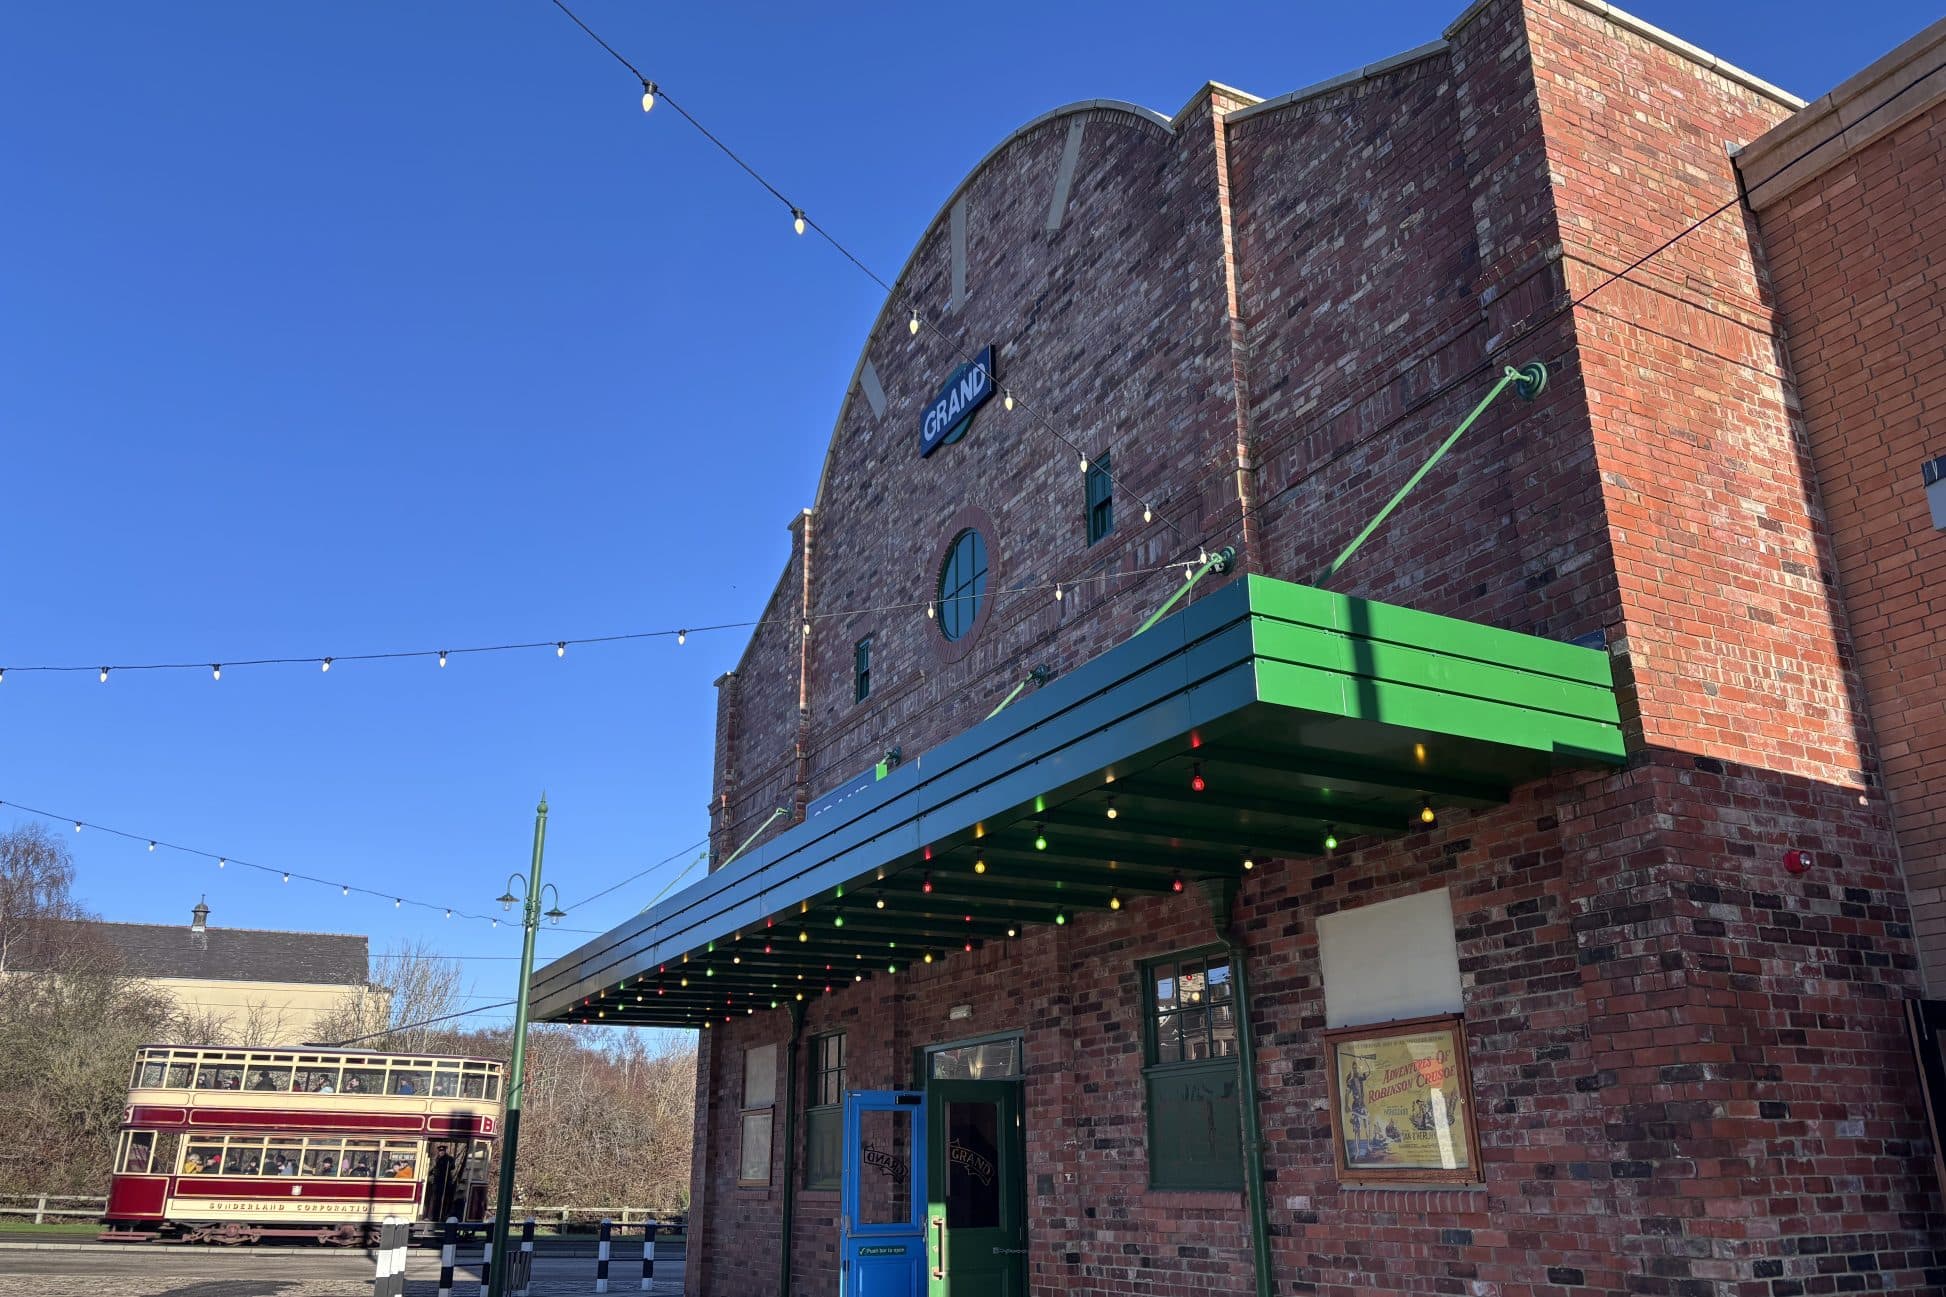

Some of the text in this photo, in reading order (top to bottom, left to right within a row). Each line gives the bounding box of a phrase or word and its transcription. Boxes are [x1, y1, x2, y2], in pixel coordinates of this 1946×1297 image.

[924, 363, 985, 441] GRAND
[1368, 1064, 1456, 1104] ROBINSON CRUSOE
[1382, 1056, 1432, 1085] ADVENTURES
[951, 1149, 991, 1176] GRAND
[208, 1203, 376, 1213] SUNDERLAND CORPORATION
